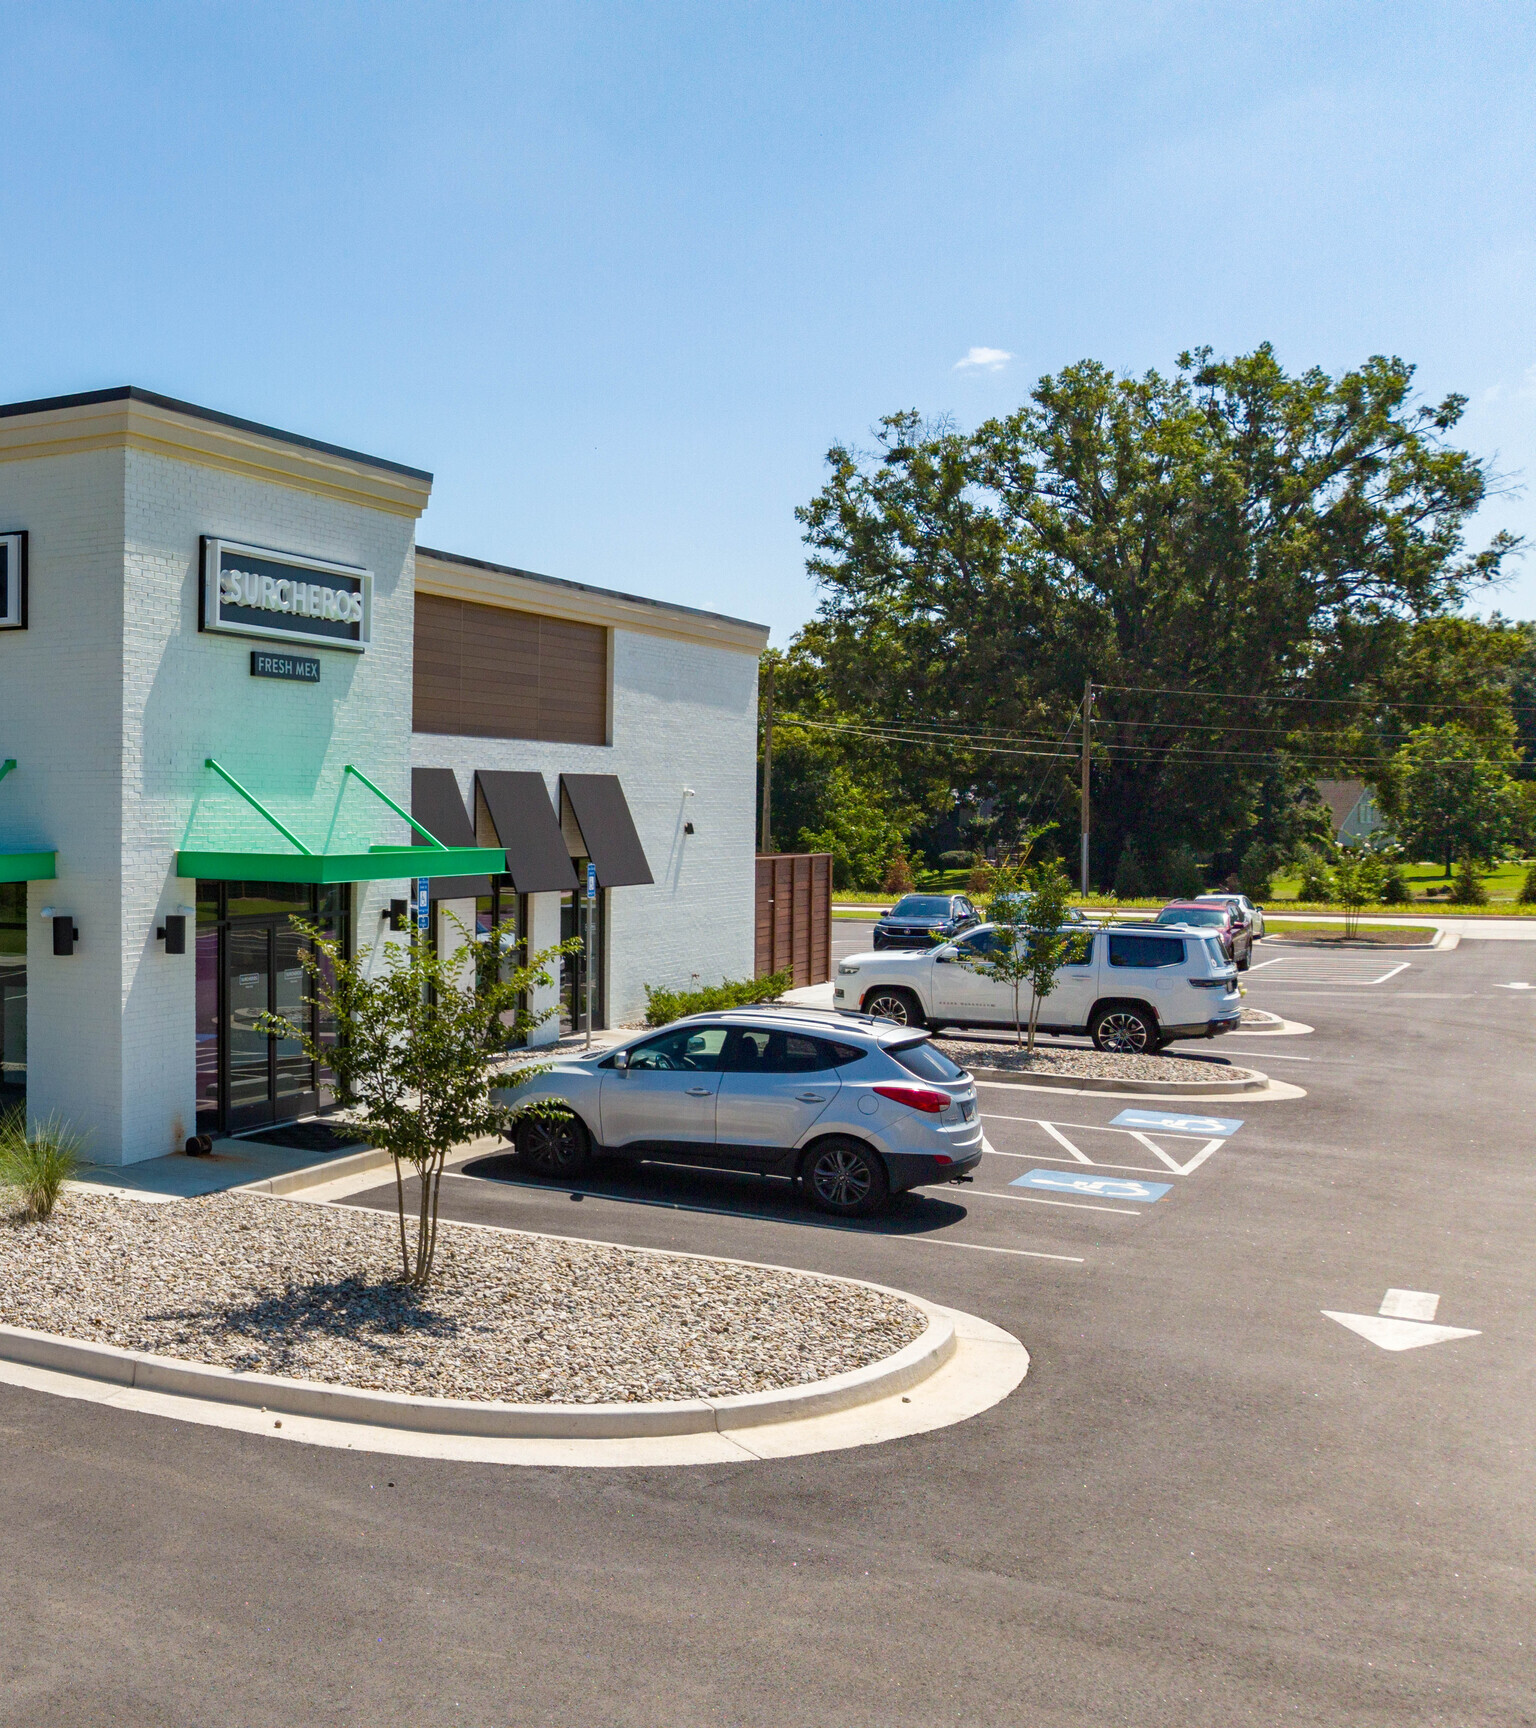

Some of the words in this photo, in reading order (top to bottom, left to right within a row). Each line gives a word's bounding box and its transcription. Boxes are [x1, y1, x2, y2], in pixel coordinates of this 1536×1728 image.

[222, 569, 363, 624] SURCHEROS
[258, 657, 293, 675] FRESH
[295, 662, 318, 679] MEX
